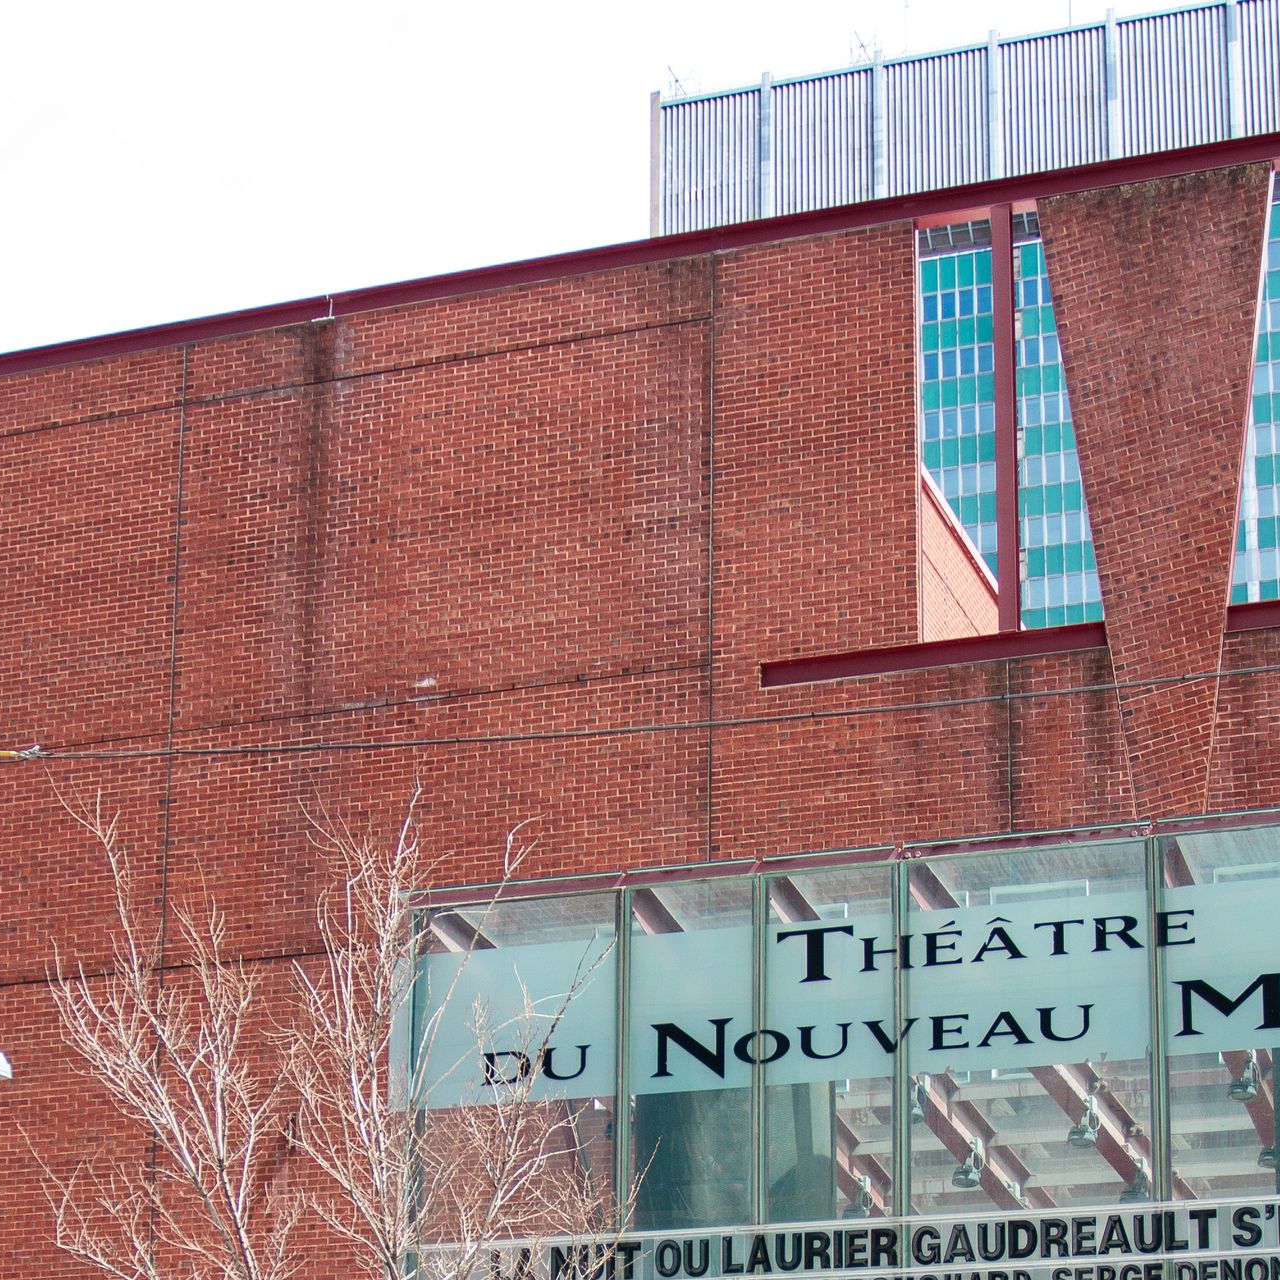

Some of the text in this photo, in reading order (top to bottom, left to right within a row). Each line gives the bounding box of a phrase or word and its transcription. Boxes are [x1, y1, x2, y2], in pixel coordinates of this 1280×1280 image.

[777, 908, 1196, 984] THÉÂTRE
[481, 1044, 592, 1087] DU
[650, 1004, 1095, 1080] NOUVEAU
[655, 1238, 710, 1278] OU
[722, 1226, 898, 1275] LAURIER
[912, 1208, 1218, 1265] GAUDREAULT
